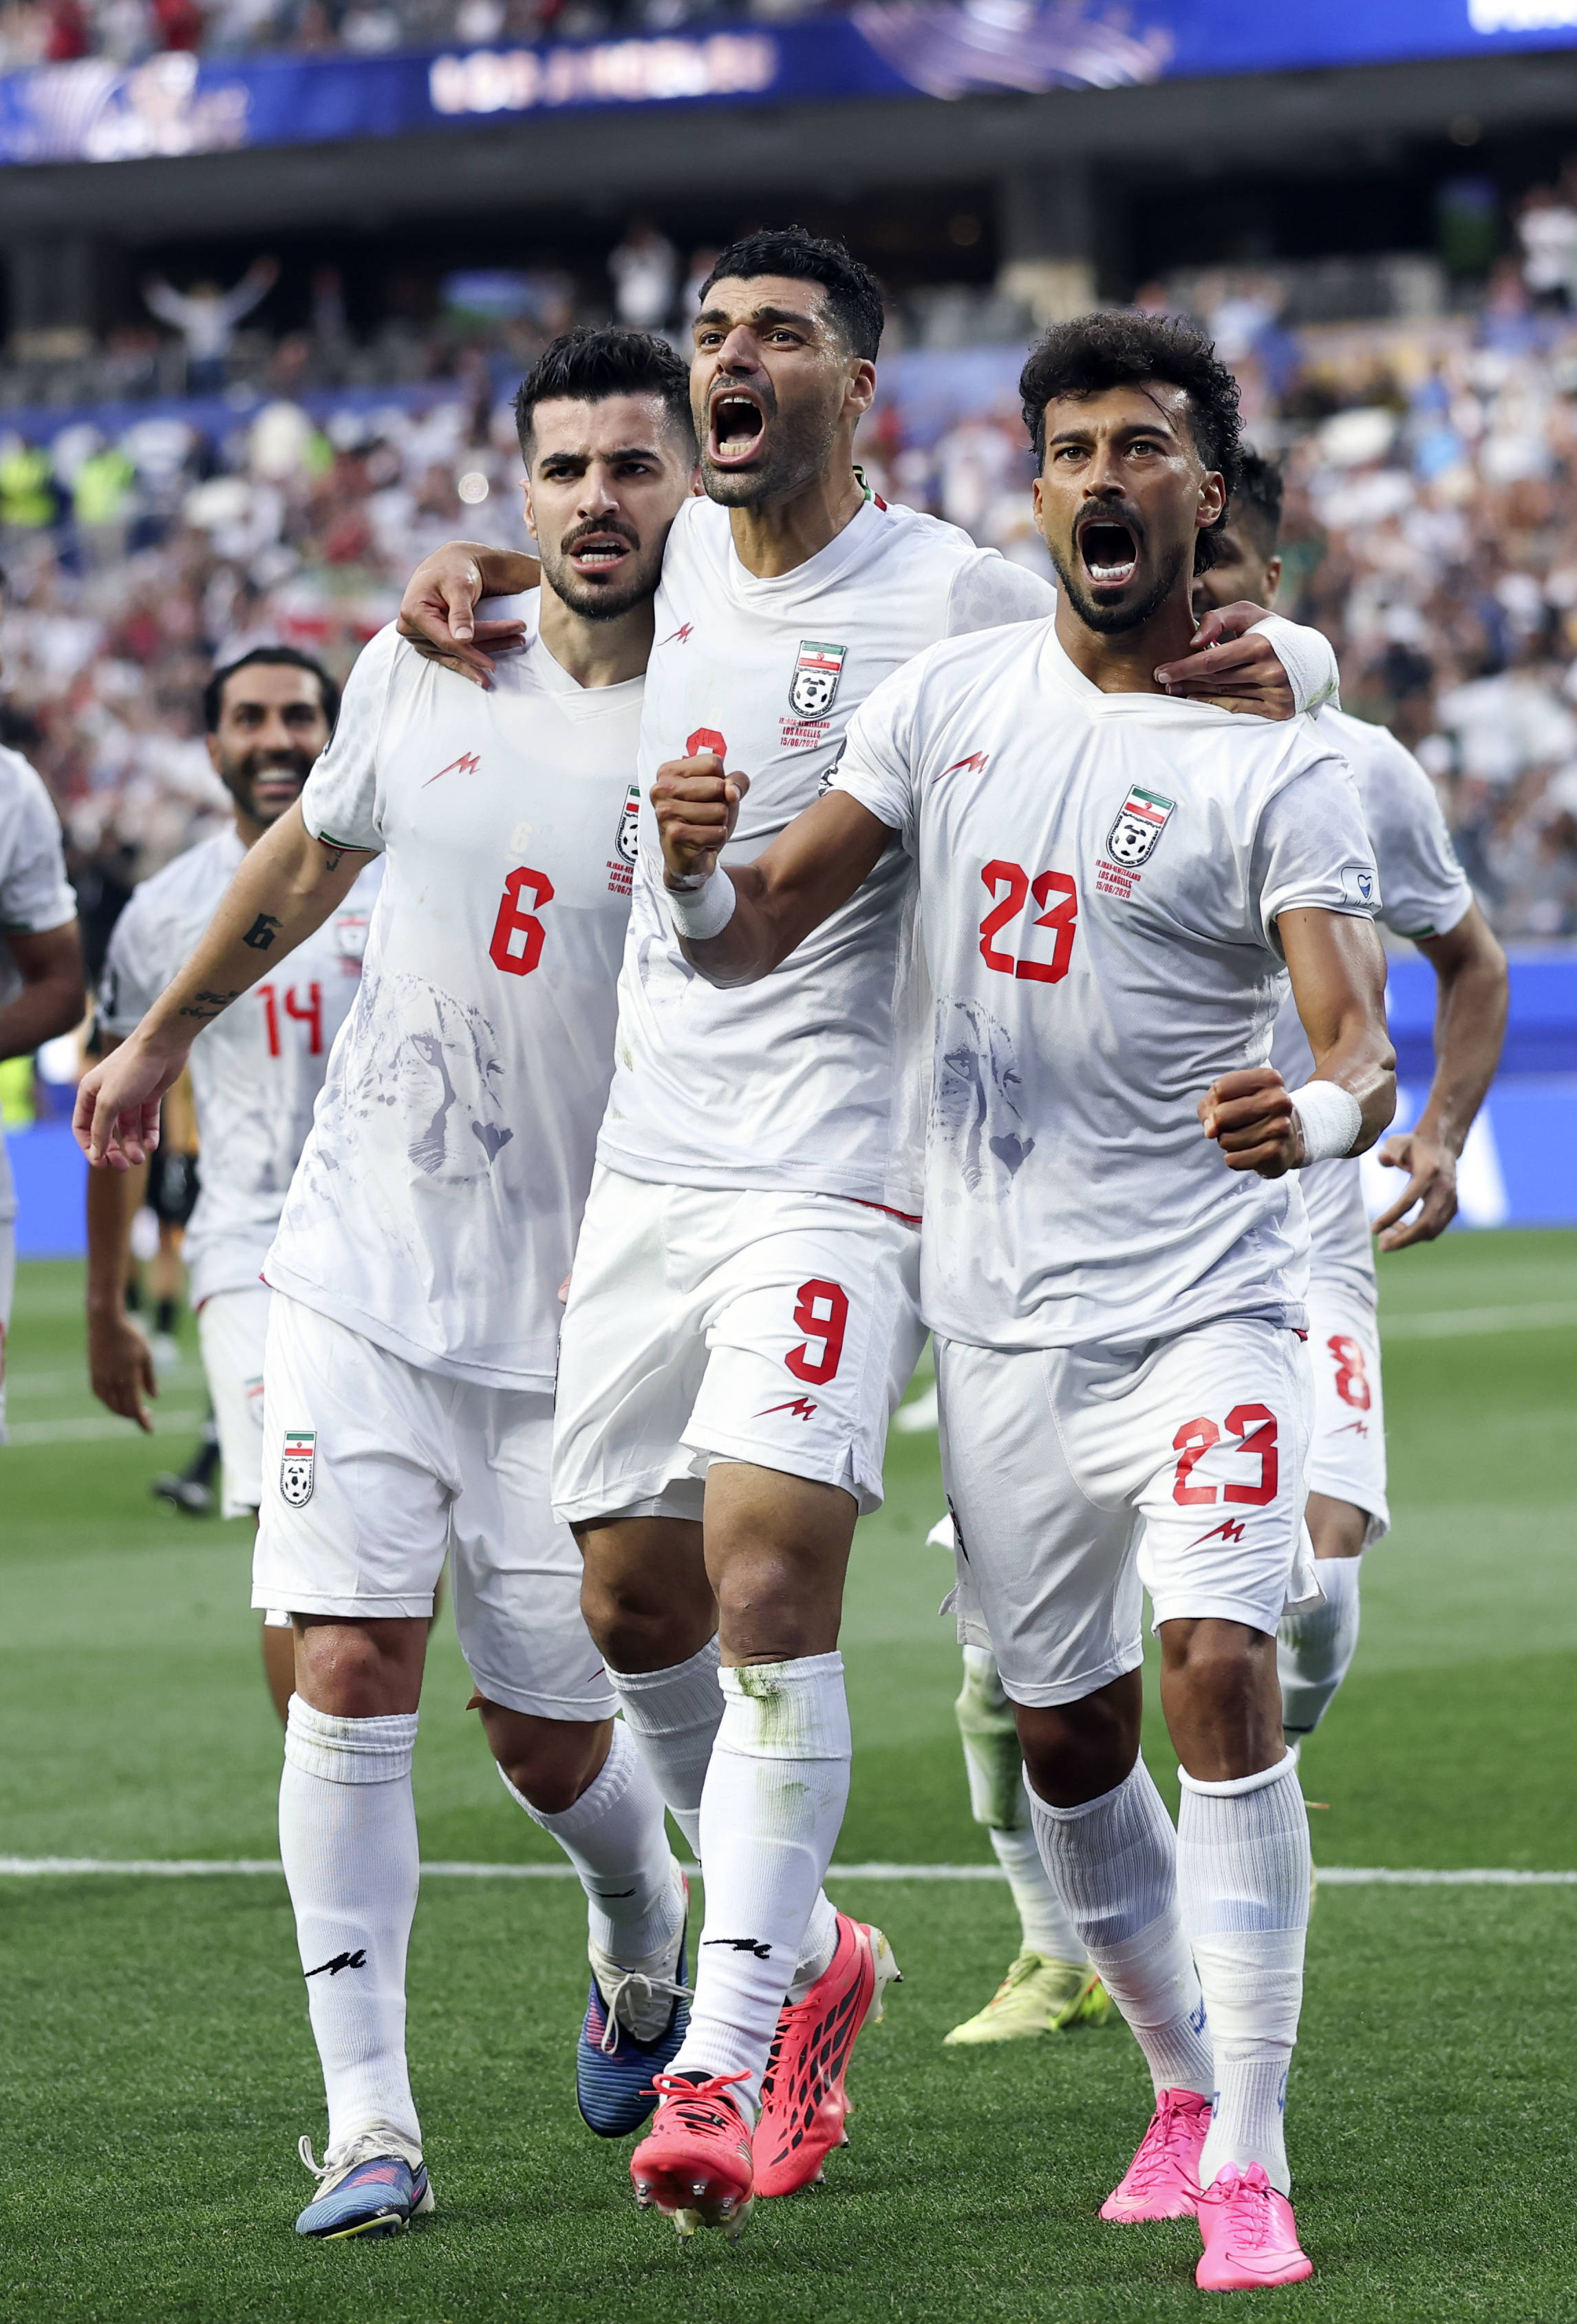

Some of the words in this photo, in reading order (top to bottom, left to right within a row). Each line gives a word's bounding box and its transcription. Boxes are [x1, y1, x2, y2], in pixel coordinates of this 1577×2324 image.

[780, 738, 819, 748] 15/06/2026
[782, 727, 795, 736] LOS
[795, 727, 822, 738] ANGELES
[608, 882, 632, 896] 15/06/2
[610, 871, 621, 881] LOS
[1096, 881, 1131, 898] 15/06/2026
[1098, 870, 1109, 880] LOS
[1110, 874, 1133, 888] ANGELES
[242, 913, 283, 950] 6
[489, 866, 555, 977] 6
[980, 860, 1077, 983] 23
[257, 982, 323, 1057] 14
[784, 1279, 849, 1385] 9
[1327, 1335, 1371, 1410] 8
[1172, 1403, 1278, 1506] 23
